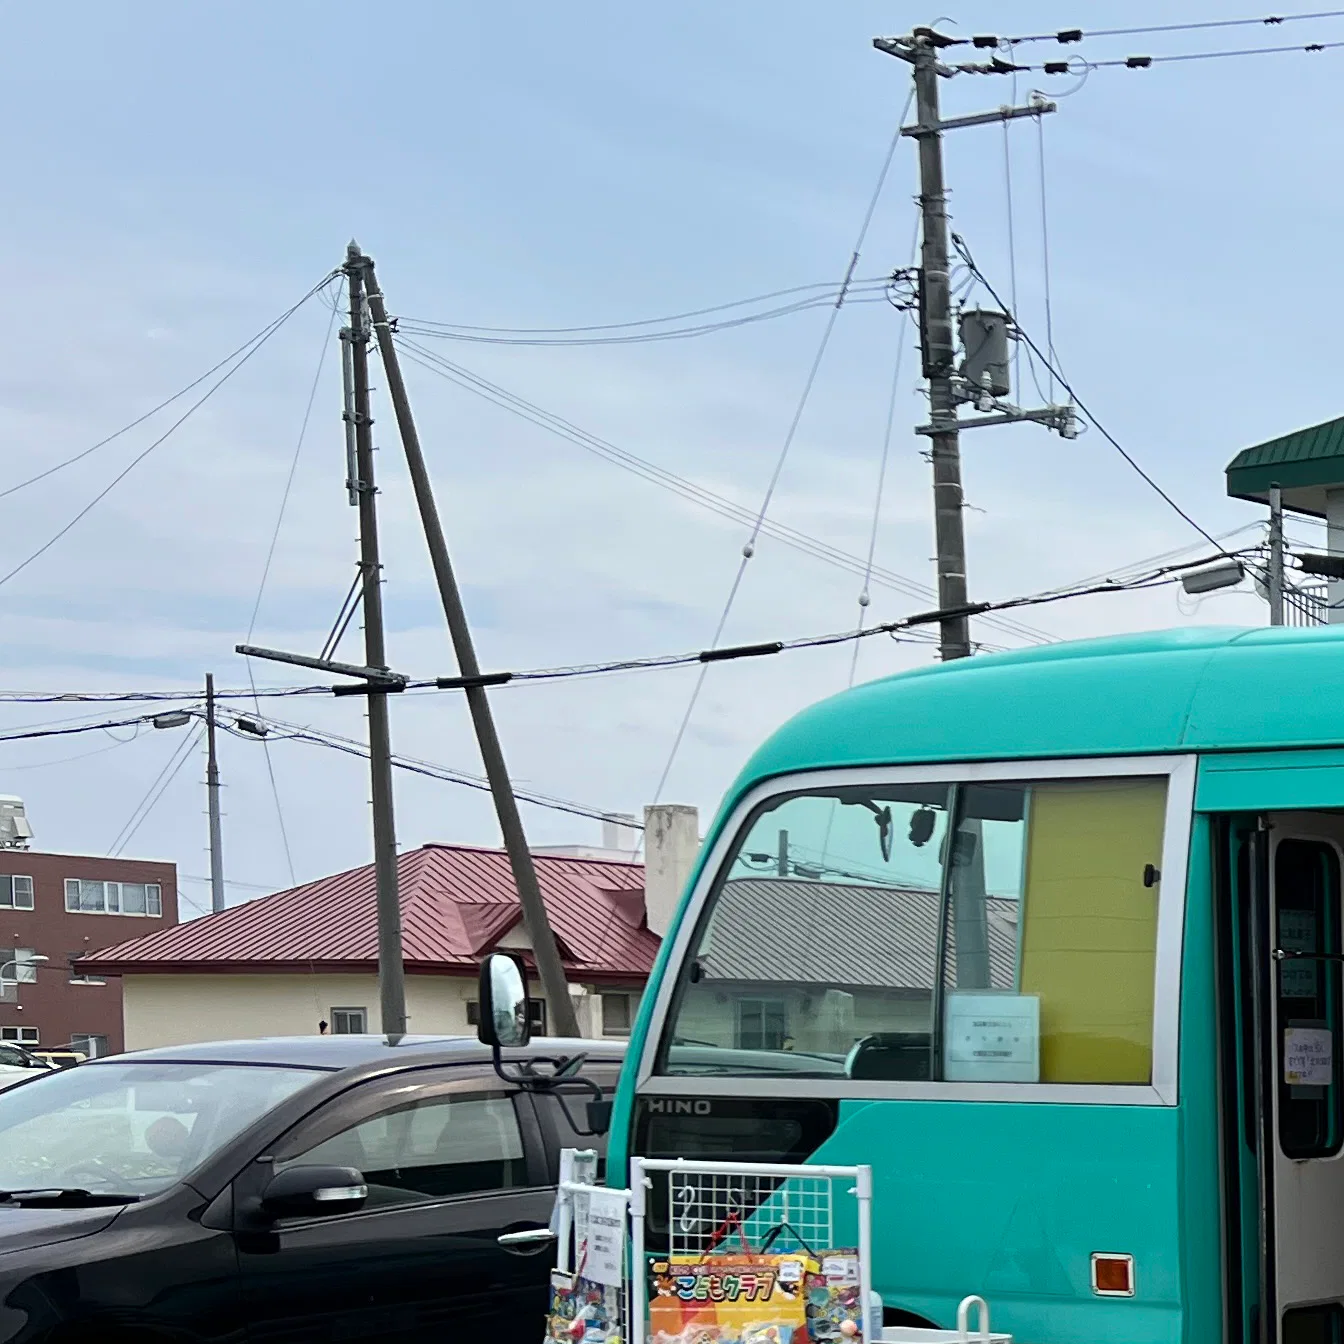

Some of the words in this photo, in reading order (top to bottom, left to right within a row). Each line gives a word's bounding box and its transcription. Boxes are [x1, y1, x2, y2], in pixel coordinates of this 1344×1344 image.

[649, 1099, 711, 1115] HINO
[676, 1272, 776, 1300] こどもクラブ
